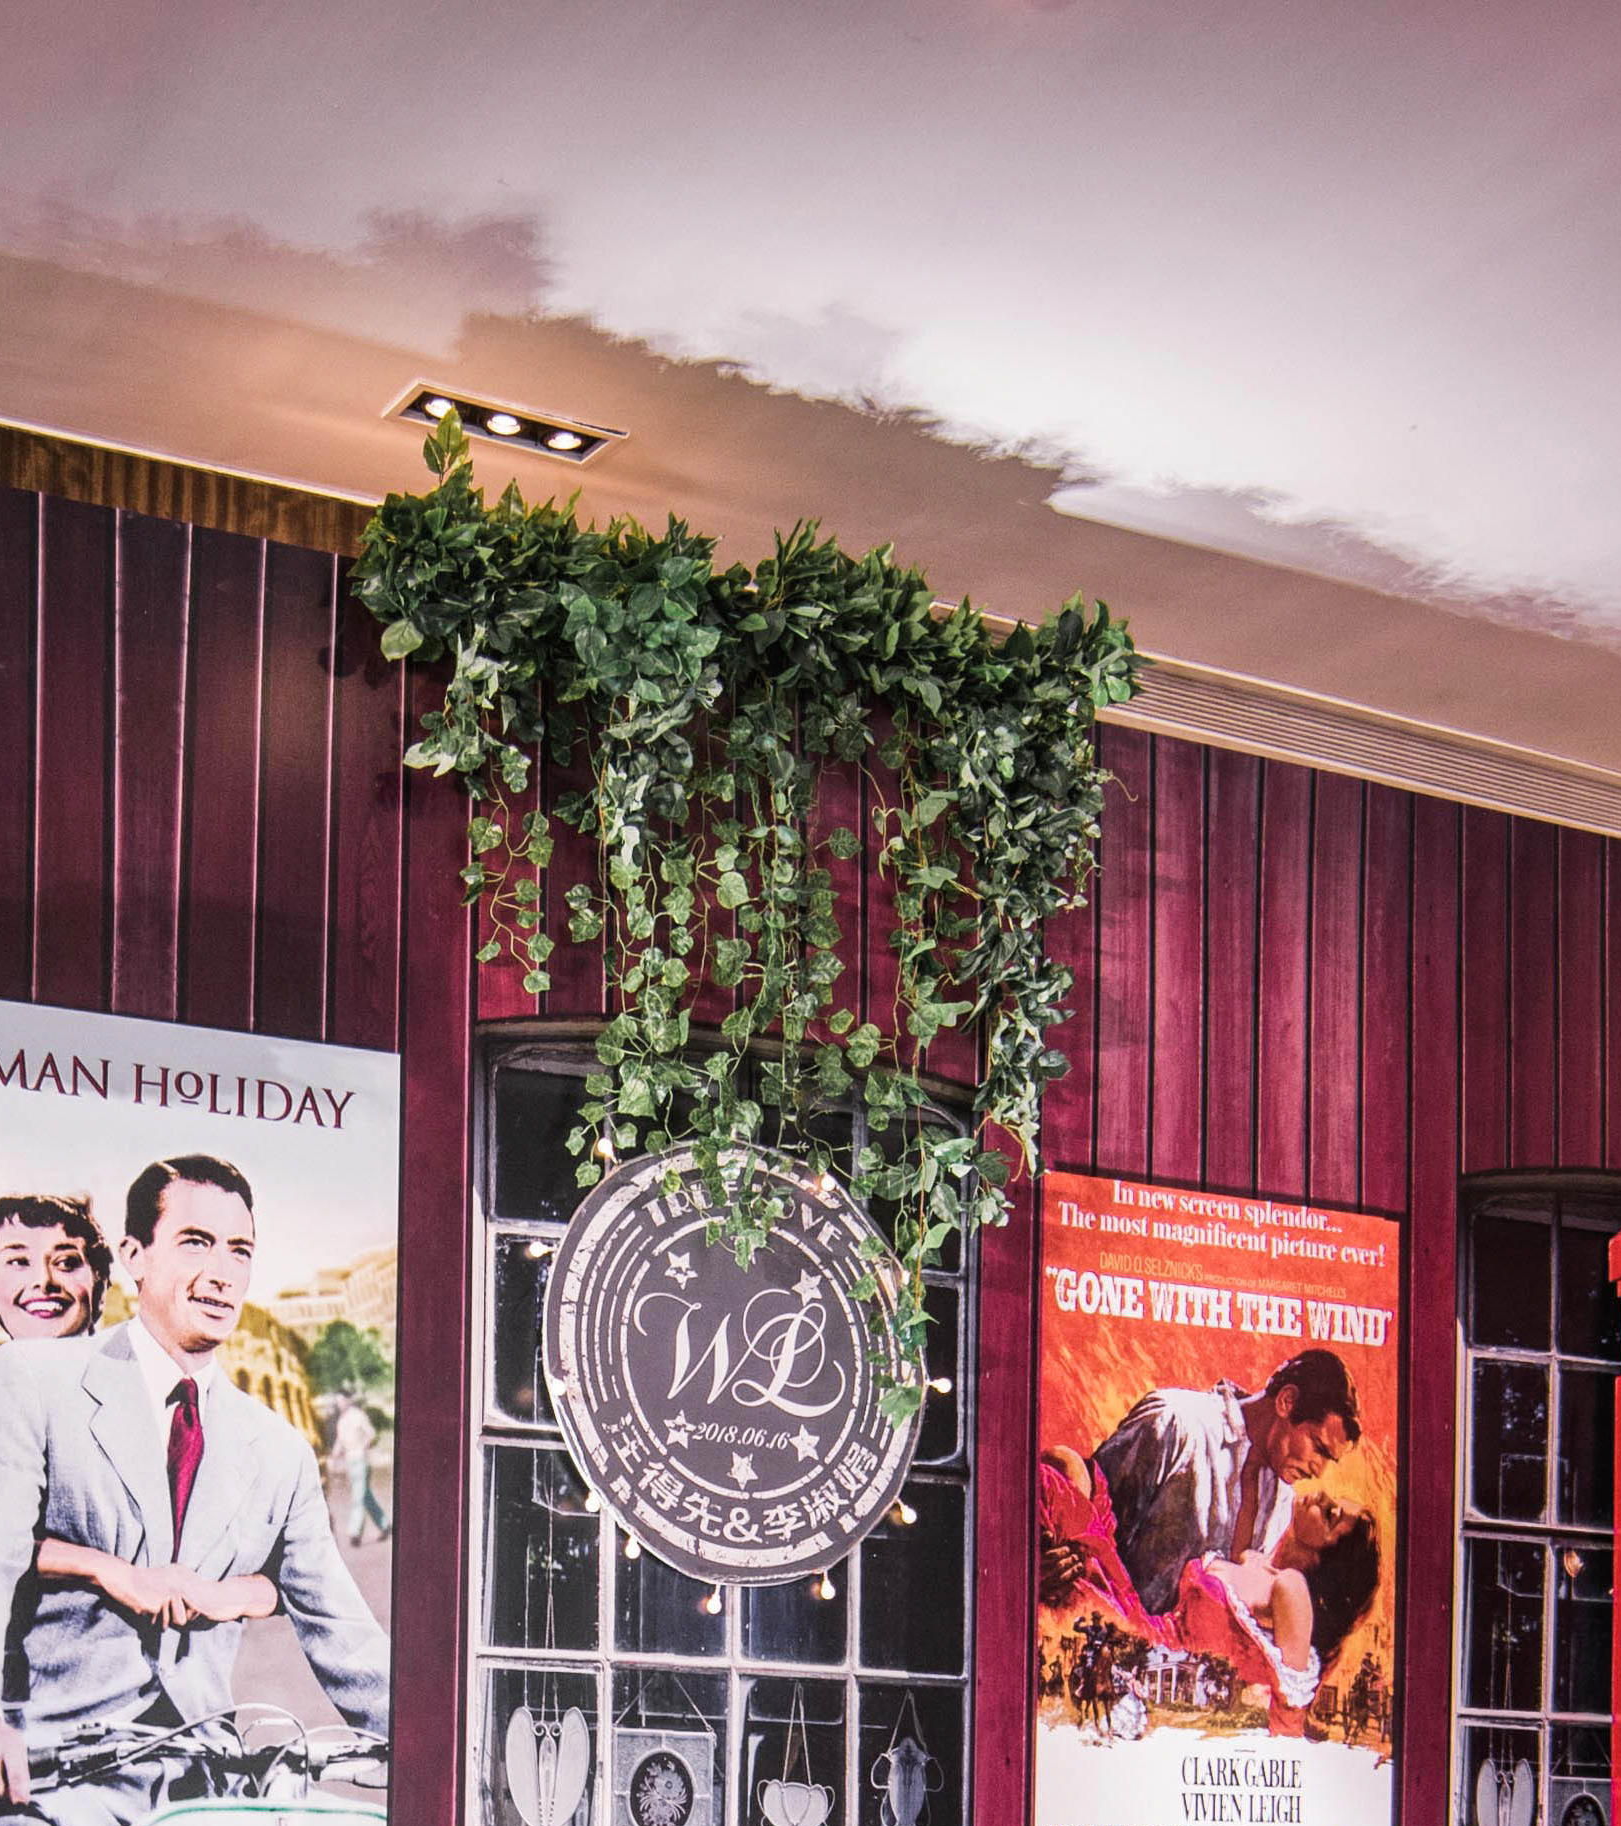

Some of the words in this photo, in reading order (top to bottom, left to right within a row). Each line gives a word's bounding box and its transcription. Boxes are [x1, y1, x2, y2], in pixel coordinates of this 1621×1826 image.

[132, 1063, 356, 1130] HOLIDAY
[1112, 1179, 1135, 1206] In
[1138, 1187, 1176, 1211] new
[1179, 1194, 1242, 1220] screen
[1058, 1200, 1096, 1230] The
[1099, 1212, 1150, 1237] most
[1153, 1220, 1268, 1252] magnificent
[1271, 1231, 1338, 1260] picture
[1340, 1243, 1387, 1268] ever!
[1099, 1251, 1132, 1271] DAVID
[1148, 1280, 1233, 1330] WITH
[1236, 1290, 1303, 1338] THE
[692, 1421, 791, 1451] 2018.06.16
[1181, 1756, 1242, 1788] CLARK
[1244, 1758, 1303, 1789] GABLE
[1181, 1793, 1243, 1824] VIVIEN
[1248, 1794, 1302, 1825] LEIGH
